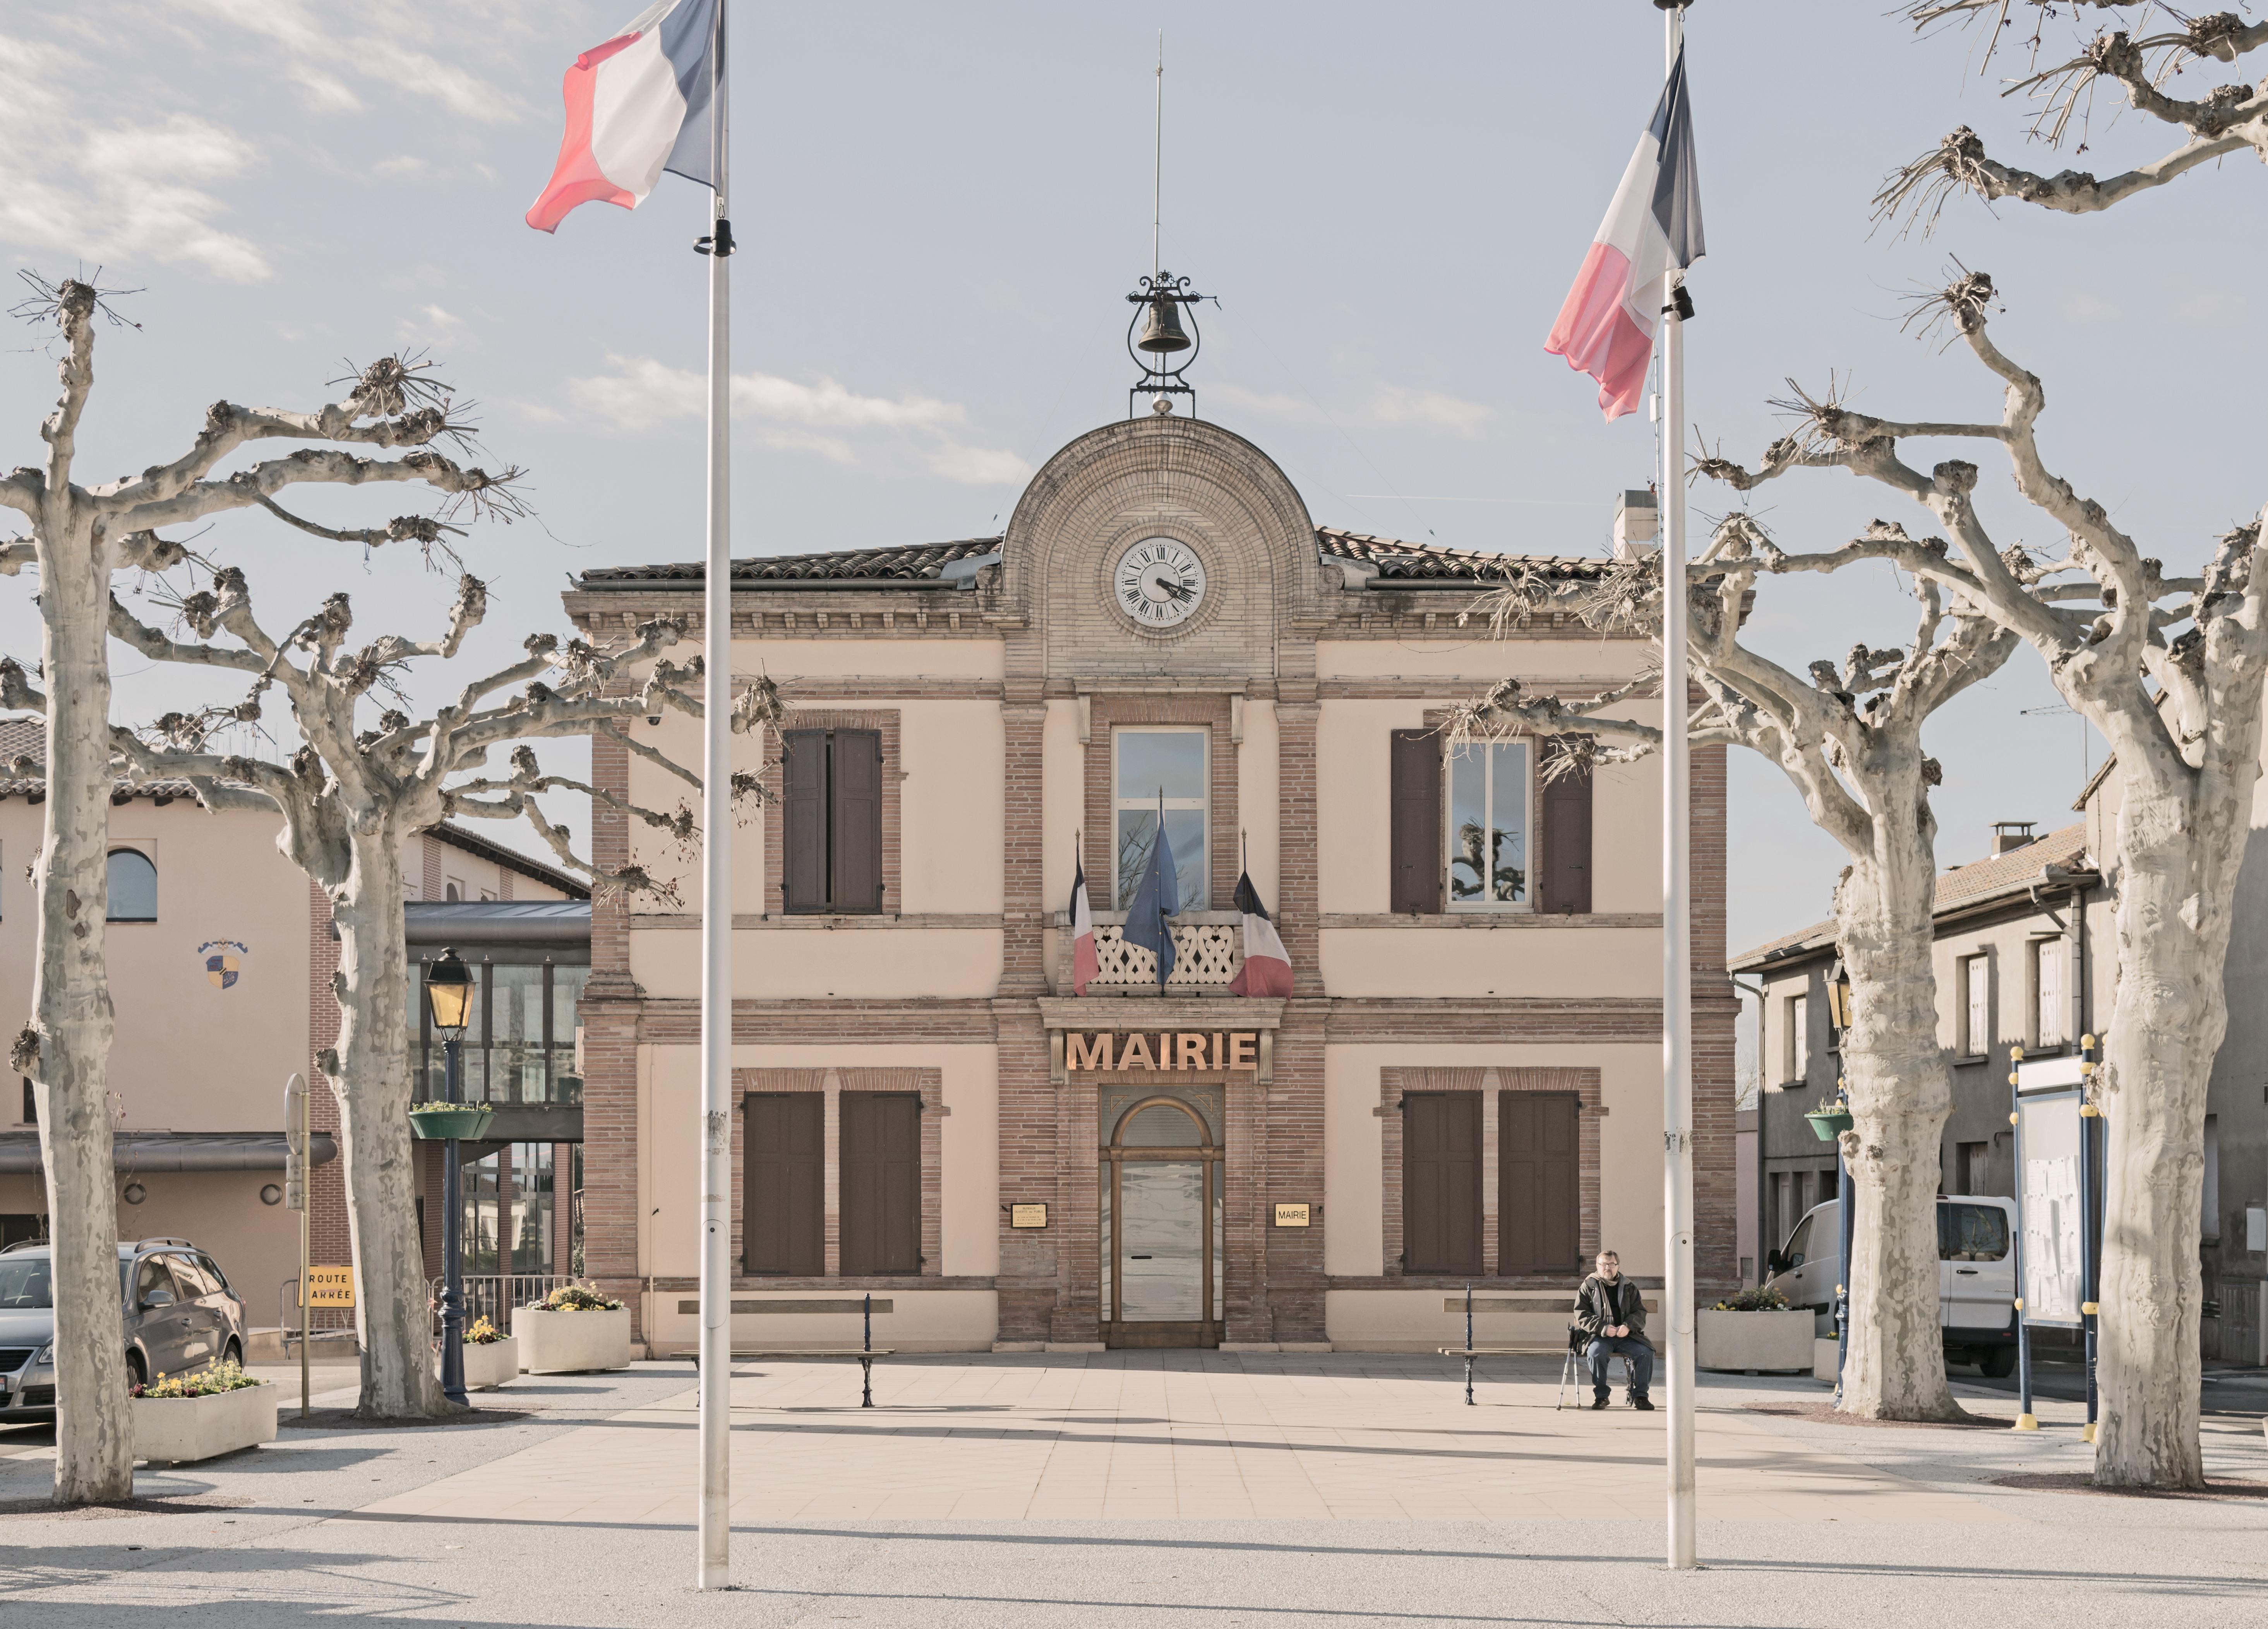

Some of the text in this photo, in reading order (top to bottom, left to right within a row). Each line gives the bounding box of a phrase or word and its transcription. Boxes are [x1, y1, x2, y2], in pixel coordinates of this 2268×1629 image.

[1140, 550, 1151, 564] XI
[1156, 547, 1165, 560] XII
[1171, 552, 1179, 563] I
[1128, 562, 1141, 573] X
[1179, 564, 1192, 573] II
[1127, 590, 1142, 604] VIII
[1138, 600, 1151, 614] VII
[1156, 605, 1162, 617] VI
[1171, 603, 1180, 614] V
[1066, 1033, 1257, 1070] MAIRIE
[312, 1289, 350, 1298] ARRÉE
